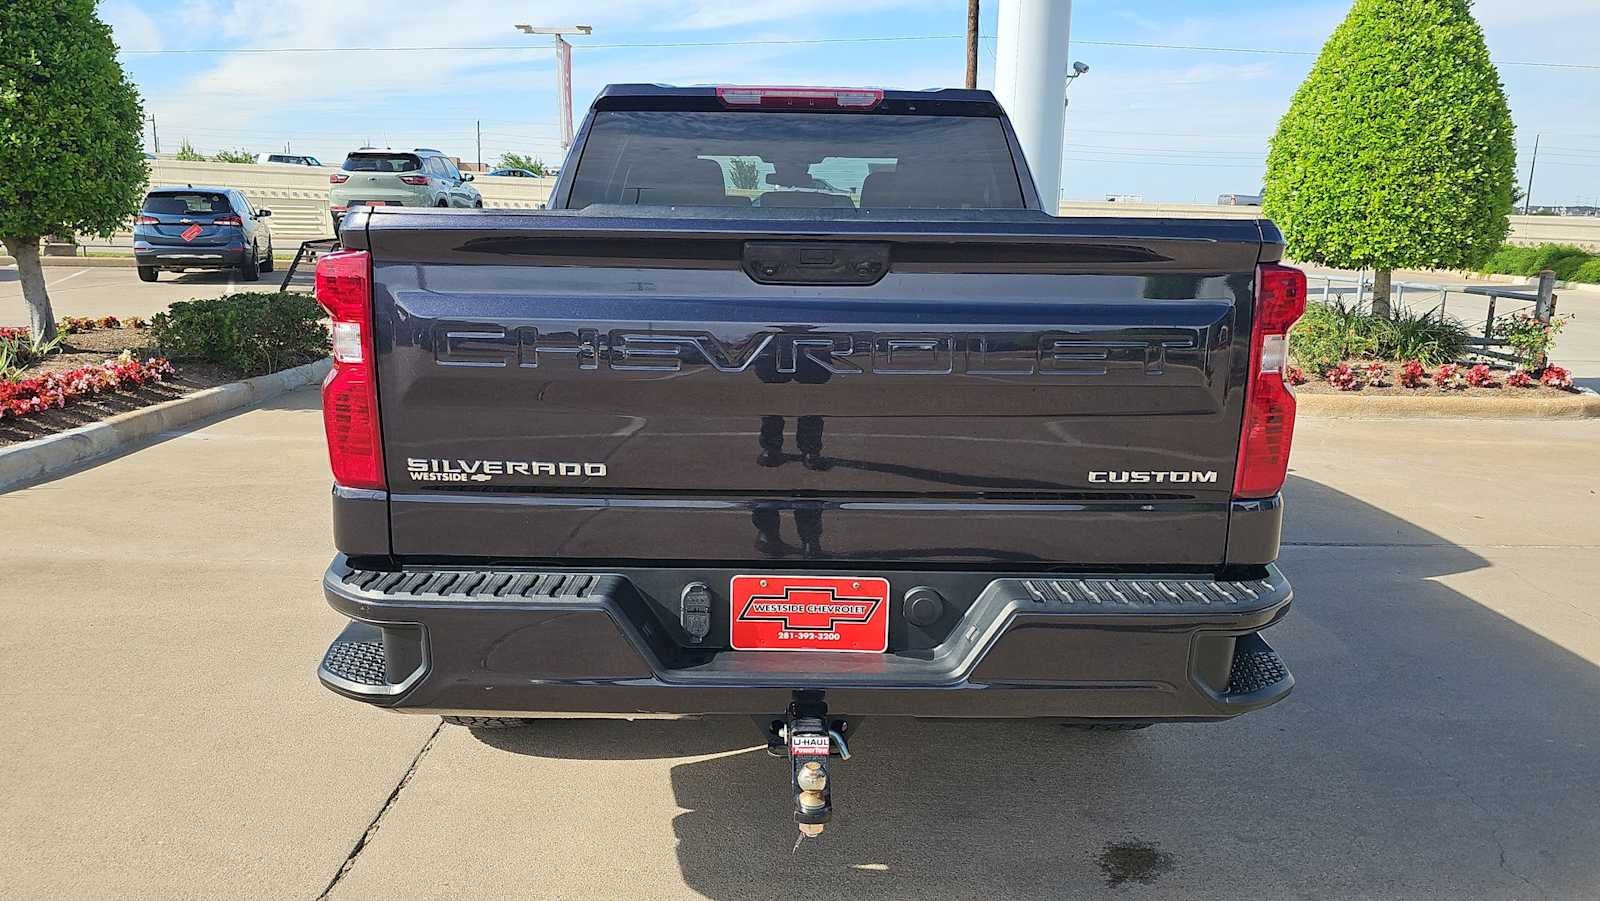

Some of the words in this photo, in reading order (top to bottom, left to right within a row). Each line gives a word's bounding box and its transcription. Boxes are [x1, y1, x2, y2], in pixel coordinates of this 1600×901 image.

[432, 323, 1200, 376] CHEVROLET
[407, 457, 608, 477] SILVERADO
[409, 471, 468, 482] WESTSIDE
[1088, 470, 1218, 483] CUSTOM
[753, 603, 804, 613] WESTSIDE
[807, 604, 866, 615] CHEVROLET
[777, 631, 841, 641] 281-392-3200
[793, 738, 829, 746] U-HAUL
